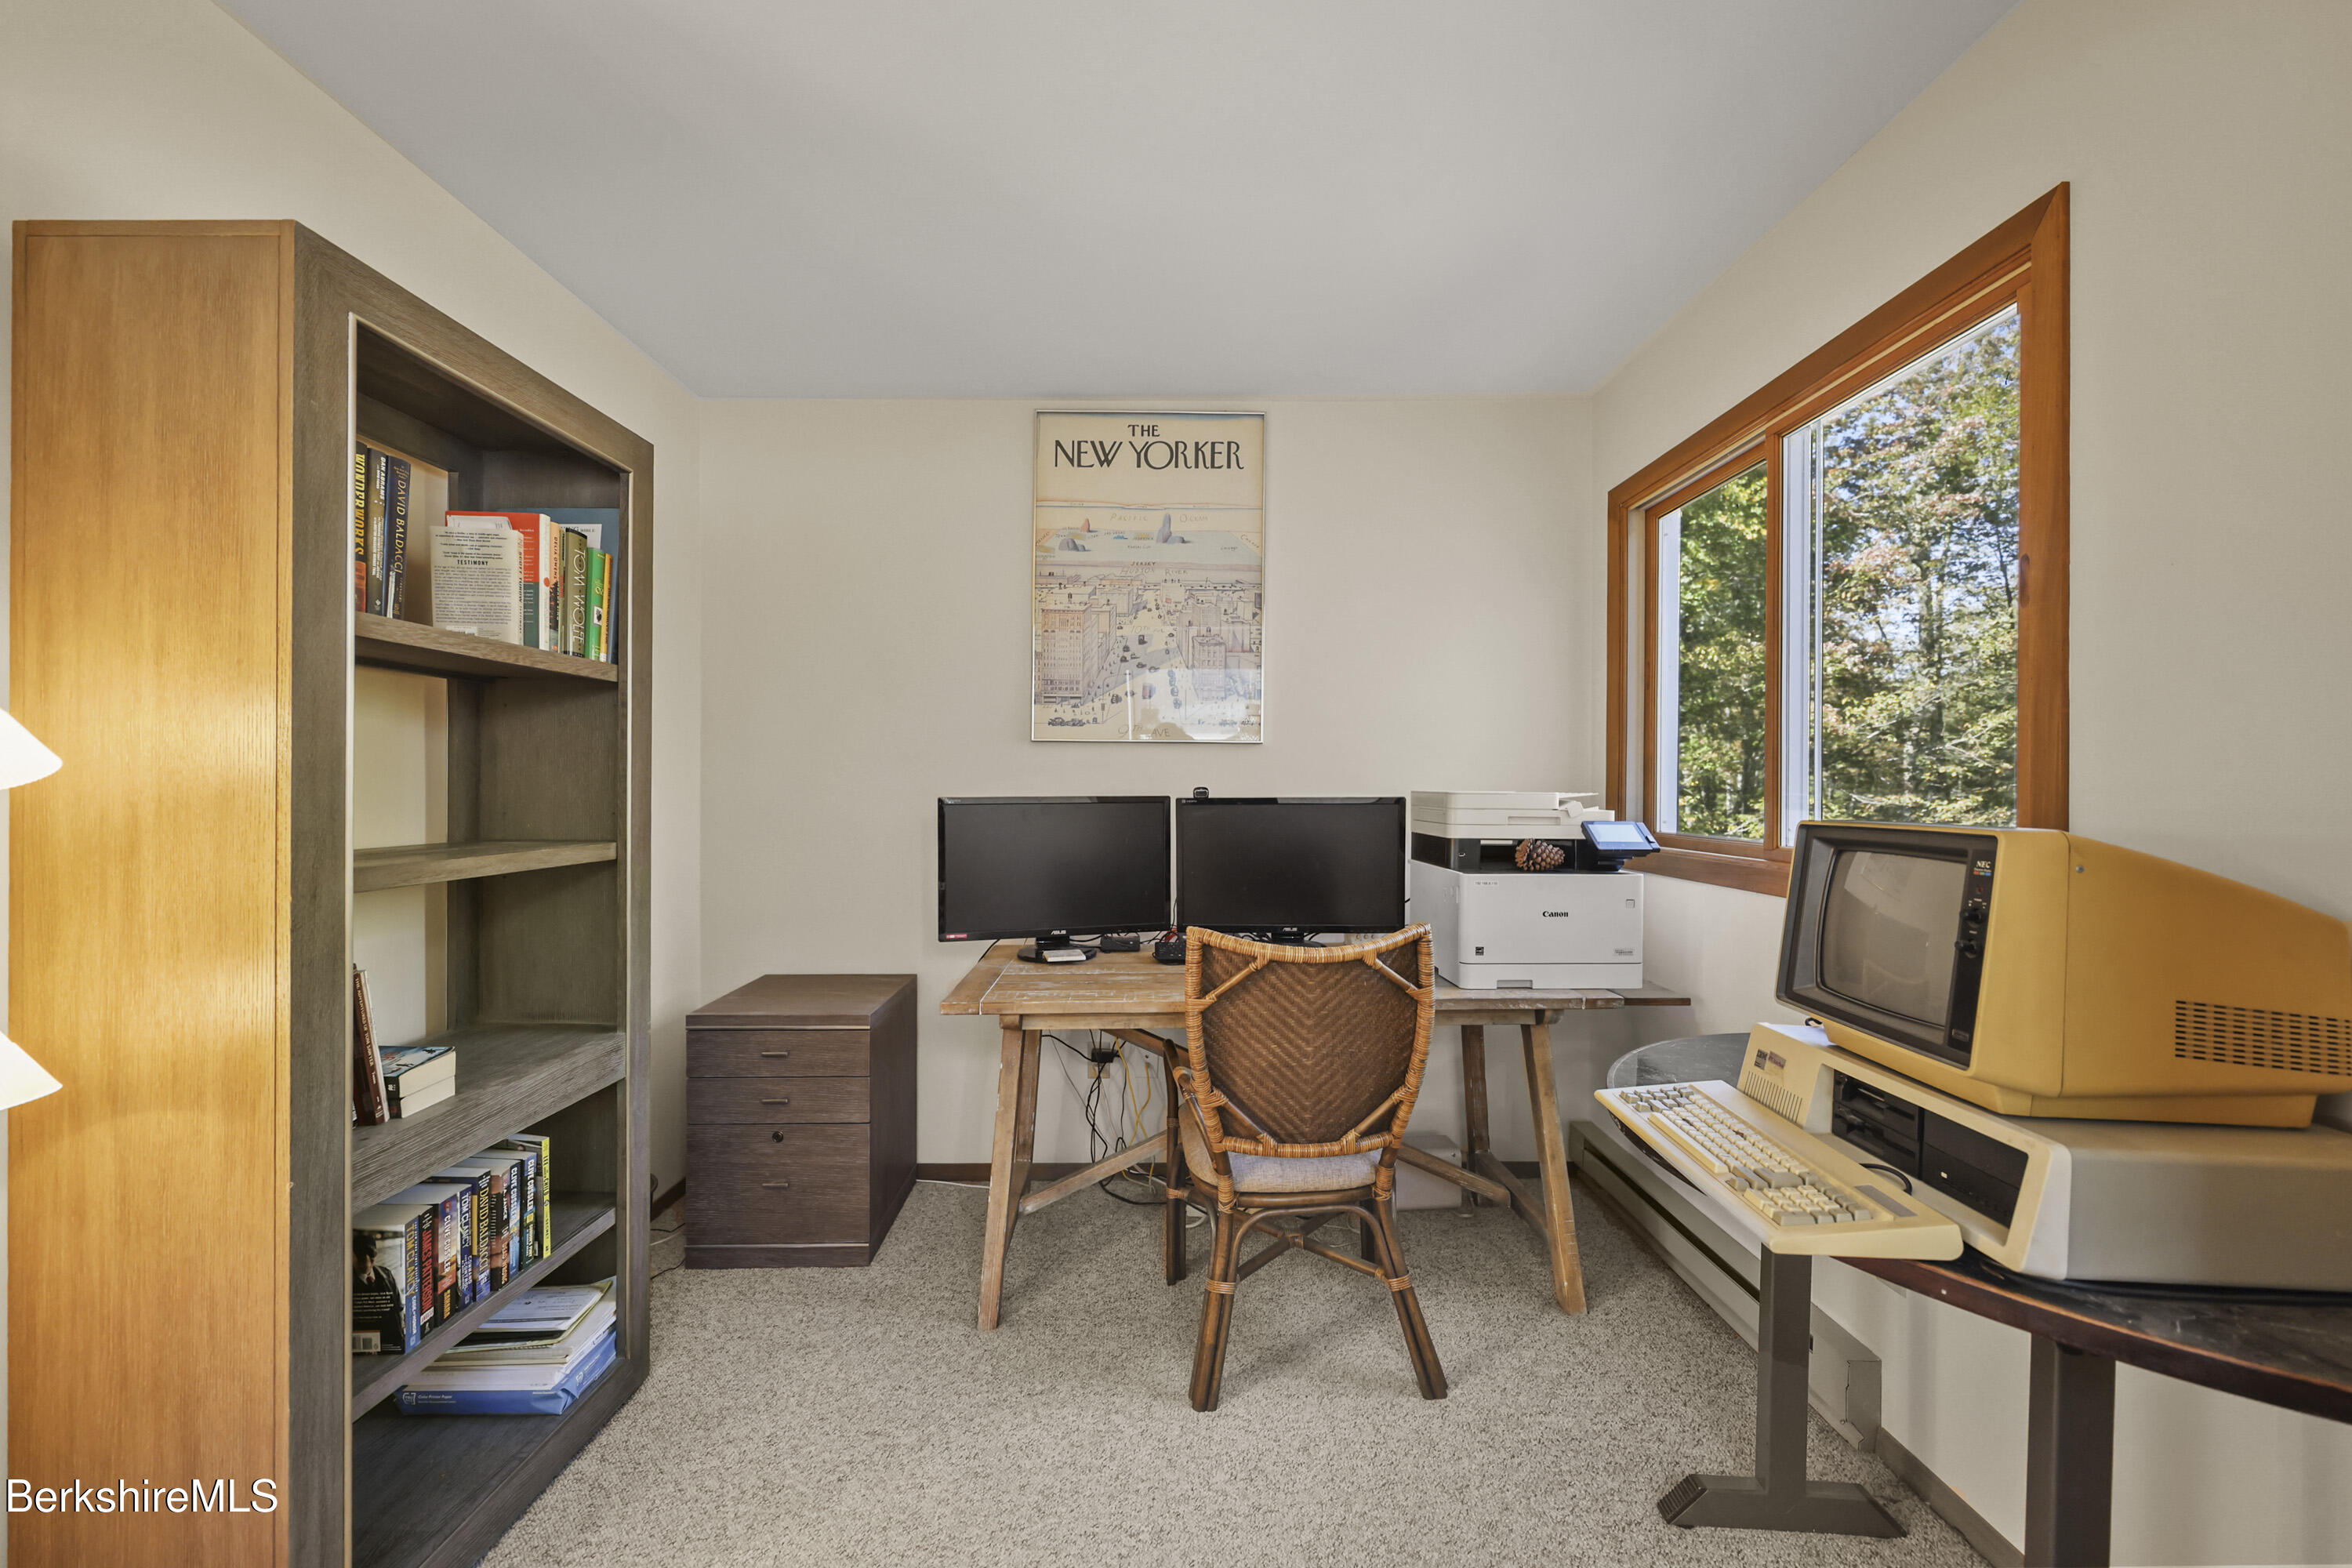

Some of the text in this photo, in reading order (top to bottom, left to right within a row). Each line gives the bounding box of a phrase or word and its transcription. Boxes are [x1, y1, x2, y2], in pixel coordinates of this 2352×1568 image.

[1127, 424, 1160, 437] THE
[1054, 439, 1244, 470] NEW YORKER
[396, 480, 406, 515] DAVID
[1109, 513, 1149, 521] PACIFIC
[394, 519, 405, 573] BALDACCI
[573, 549, 586, 586] TOM
[572, 595, 586, 644] WOLFE
[1152, 728, 1171, 737] AVE
[357, 989, 366, 1024] ADVENTURES
[479, 1187, 489, 1220] DAVID
[406, 1225, 415, 1248] TOM
[421, 1230, 433, 1261] JAMES
[461, 1213, 470, 1249] CLANCY
[479, 1220, 489, 1271] BALDACCI
[406, 1250, 416, 1297] CLANCY
[421, 1260, 433, 1313] PATTERSON
